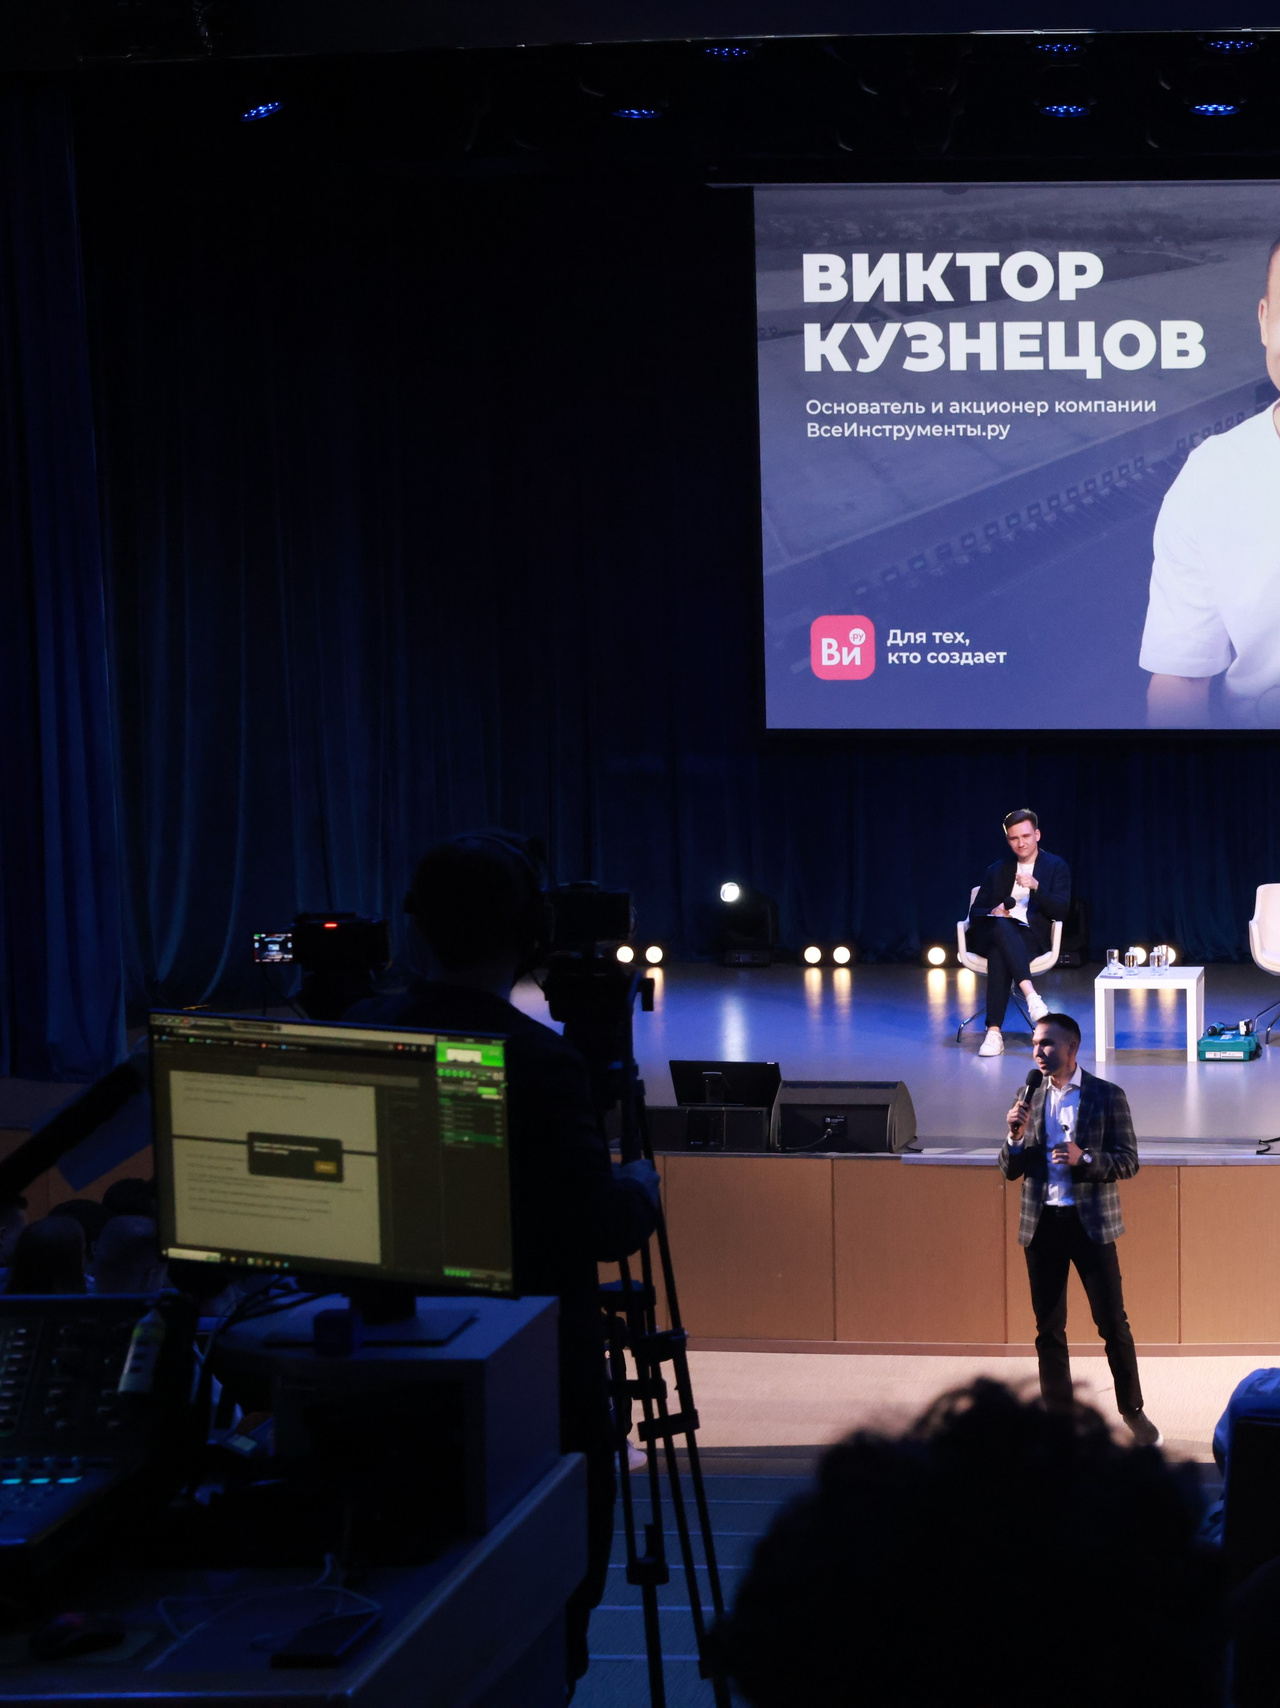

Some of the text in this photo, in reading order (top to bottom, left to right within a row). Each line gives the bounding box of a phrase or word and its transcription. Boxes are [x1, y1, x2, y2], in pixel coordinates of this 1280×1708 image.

[802, 250, 1104, 303] ВИКТОР
[803, 319, 1206, 379] КУЗНЕЦОВ
[806, 399, 1157, 417] Основатель и акционер компании
[806, 422, 1010, 440] ВсеИнструменты.ру
[887, 629, 970, 647] Для тех,
[821, 637, 862, 666] Ви
[888, 651, 1007, 666] кто создает
